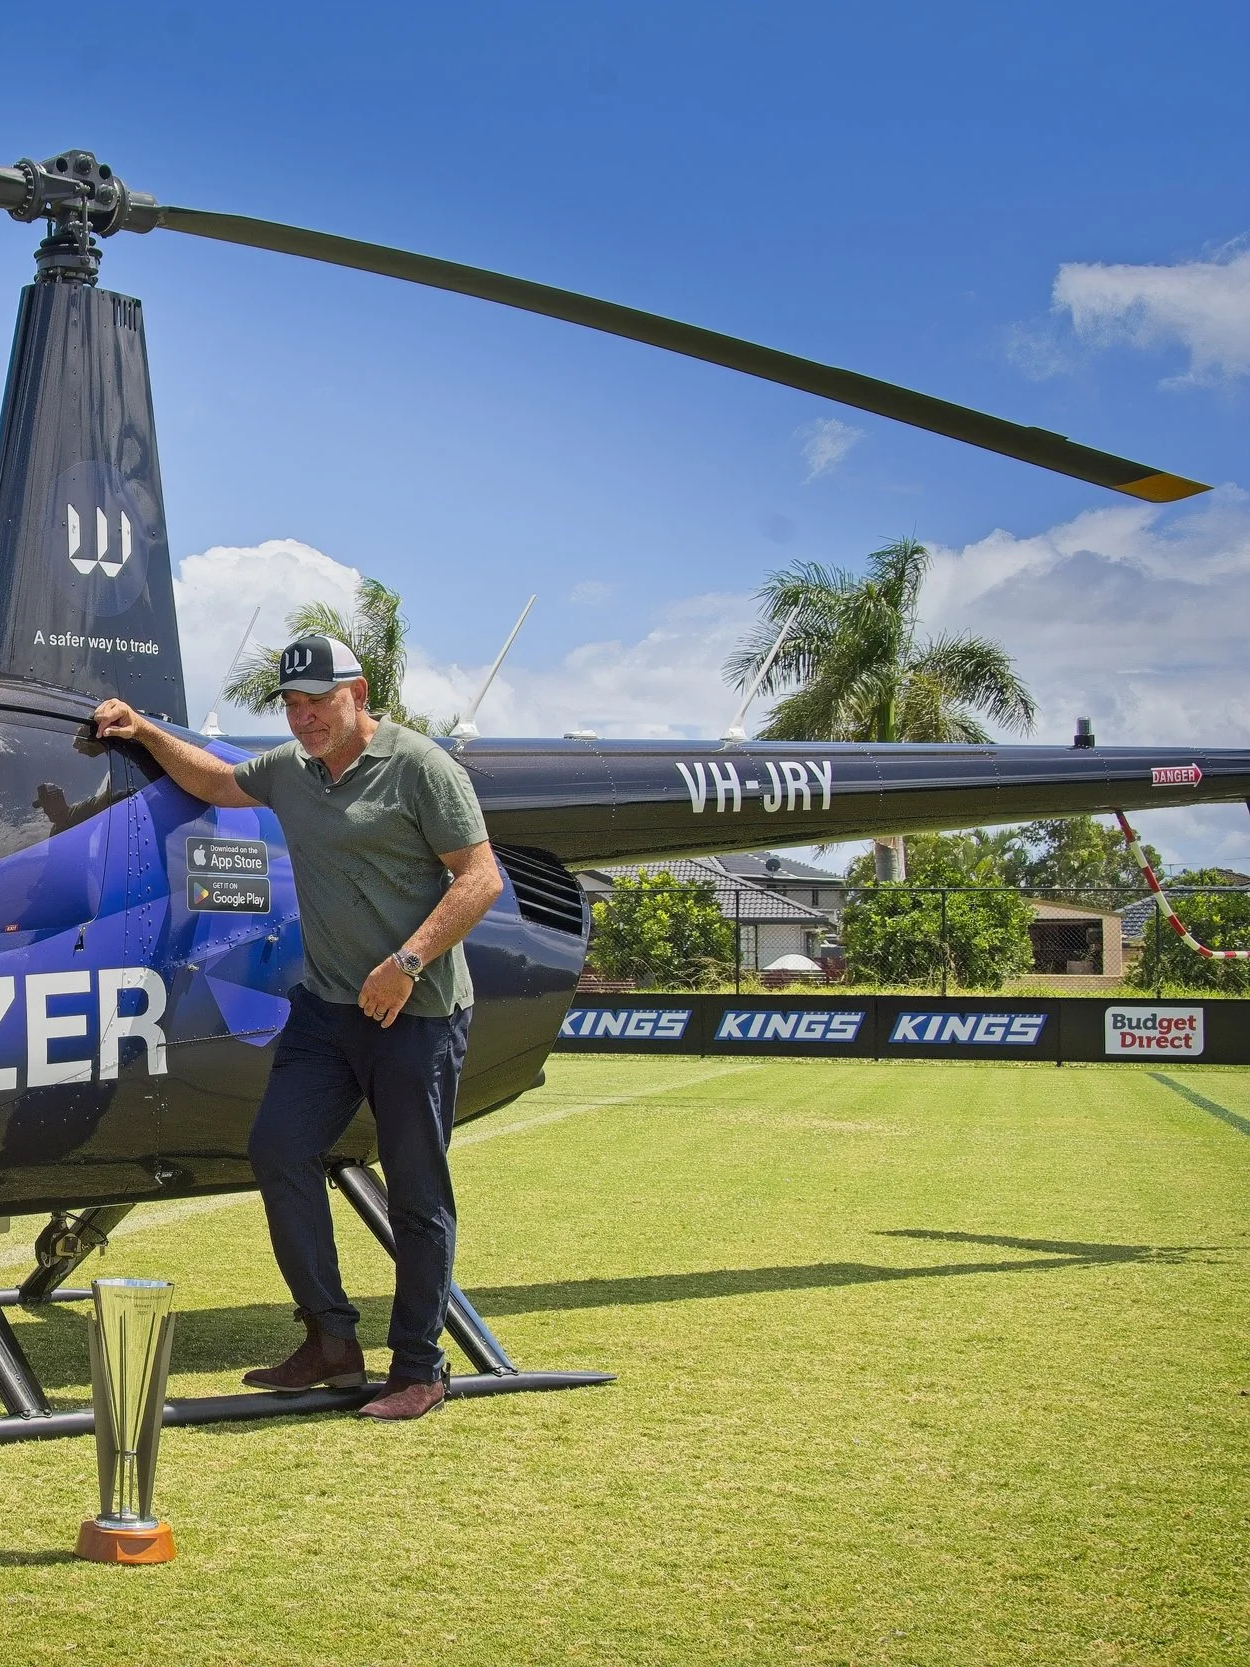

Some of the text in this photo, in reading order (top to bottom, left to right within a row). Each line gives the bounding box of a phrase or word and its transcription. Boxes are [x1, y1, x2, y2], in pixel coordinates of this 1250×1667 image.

[33, 630, 159, 655] A safer way to trade
[675, 760, 832, 814] VH-JRY
[1151, 769, 1196, 784] DANGER
[210, 844, 239, 853] Download
[248, 846, 258, 854] the
[210, 853, 263, 870] App Store
[212, 890, 265, 908] Google Play
[561, 1011, 688, 1037] KINGS
[719, 1013, 861, 1039] KINGS
[893, 1015, 1043, 1042] KINGS
[1111, 1013, 1197, 1035] Budget
[1119, 1031, 1193, 1049] Direct
